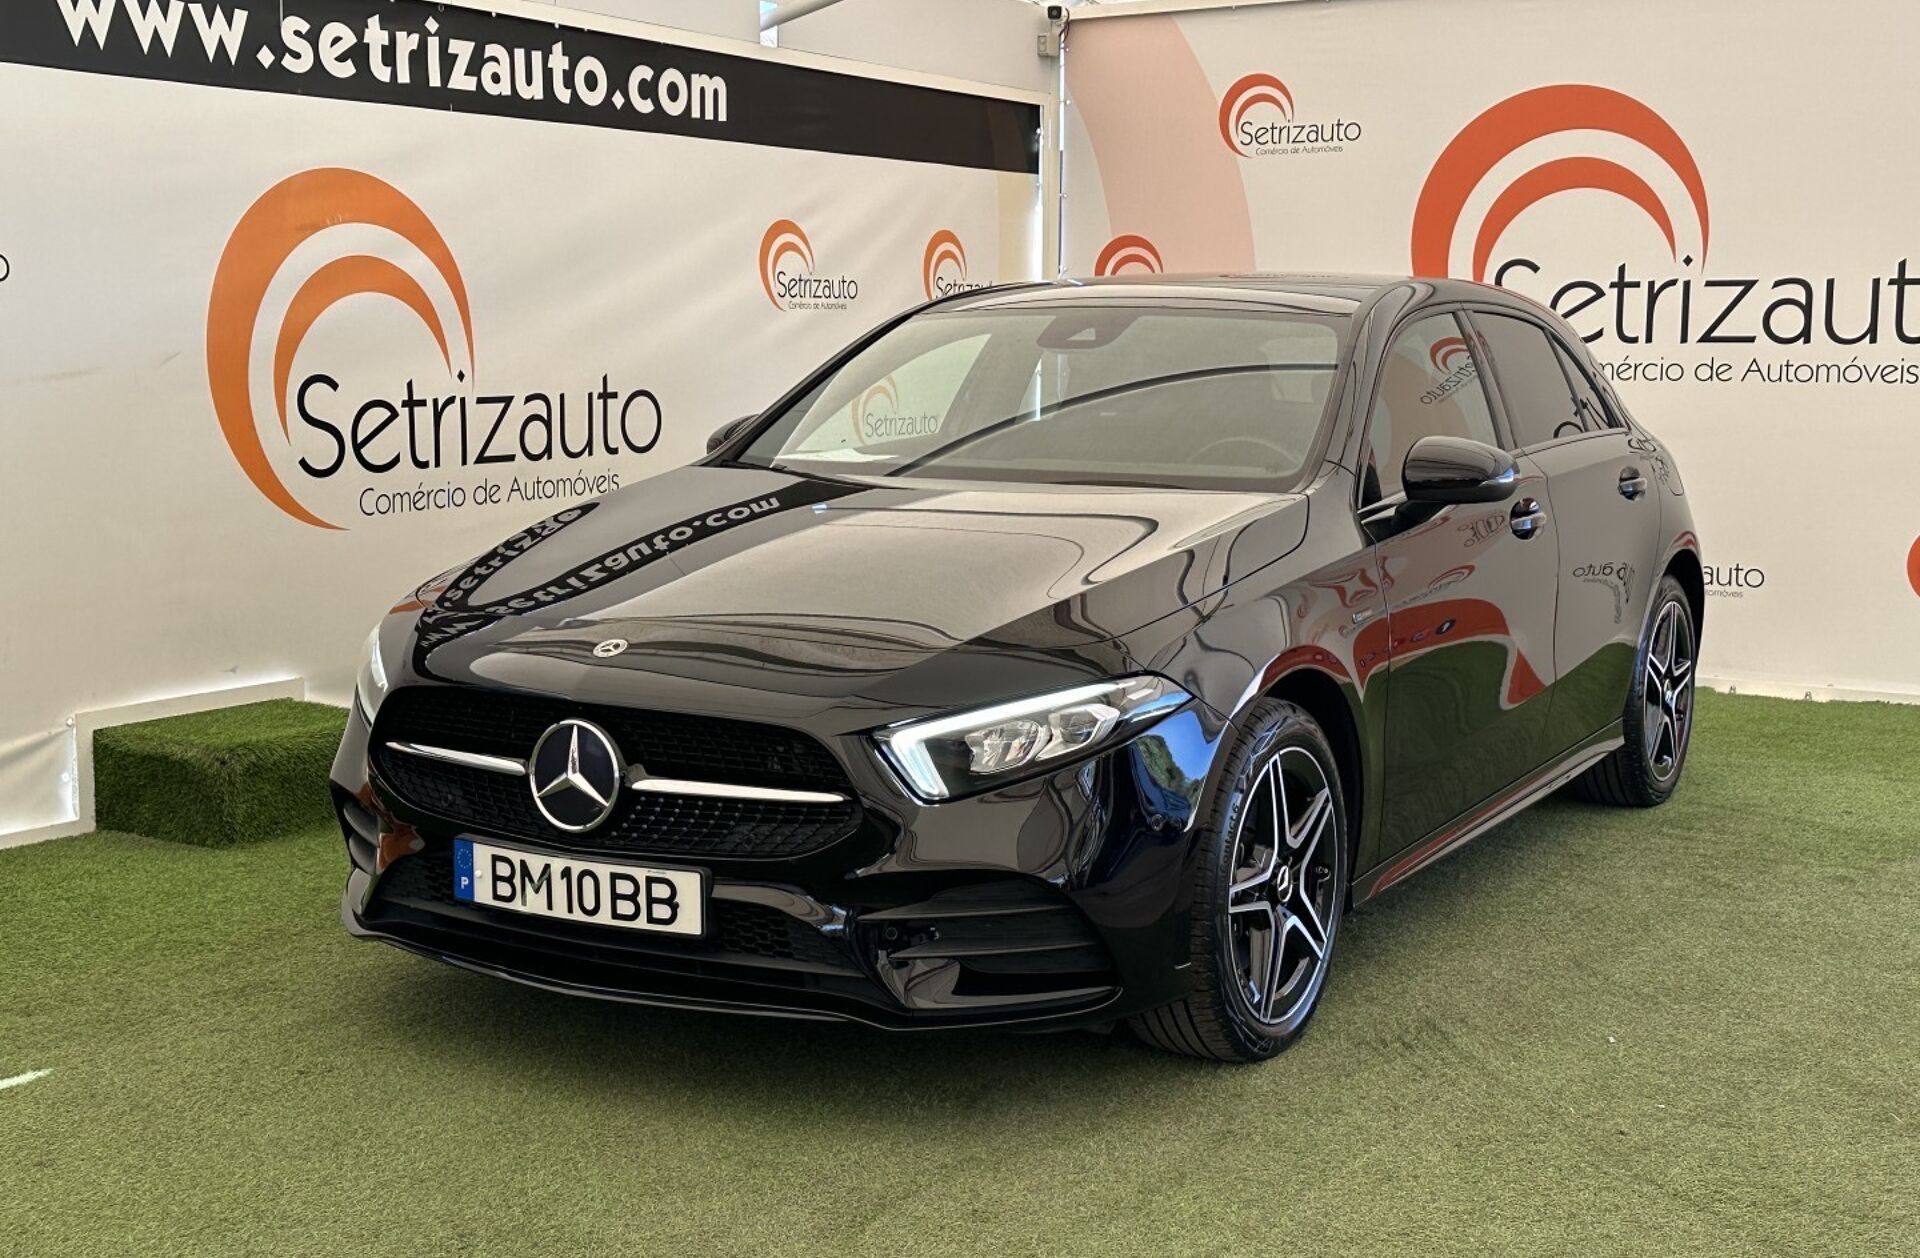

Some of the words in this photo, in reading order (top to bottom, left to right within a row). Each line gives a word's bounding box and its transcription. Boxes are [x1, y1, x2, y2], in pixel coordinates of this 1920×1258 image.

[56, 0, 728, 122] www.setrizauto.com
[1240, 118, 1362, 146] Setrizauto
[776, 270, 859, 299] Setrizauto
[1494, 254, 1920, 345] etrizaut
[1599, 354, 1685, 382] mércio
[1694, 356, 1733, 382] de
[1741, 355, 1920, 385] Automóveis
[296, 369, 663, 478] Setrizauto
[864, 410, 939, 438] Setrizauto
[359, 482, 467, 516] Comércio
[473, 477, 502, 505] de
[506, 468, 621, 504] Automóveis
[1702, 562, 1765, 588] auto
[460, 876, 470, 890] P
